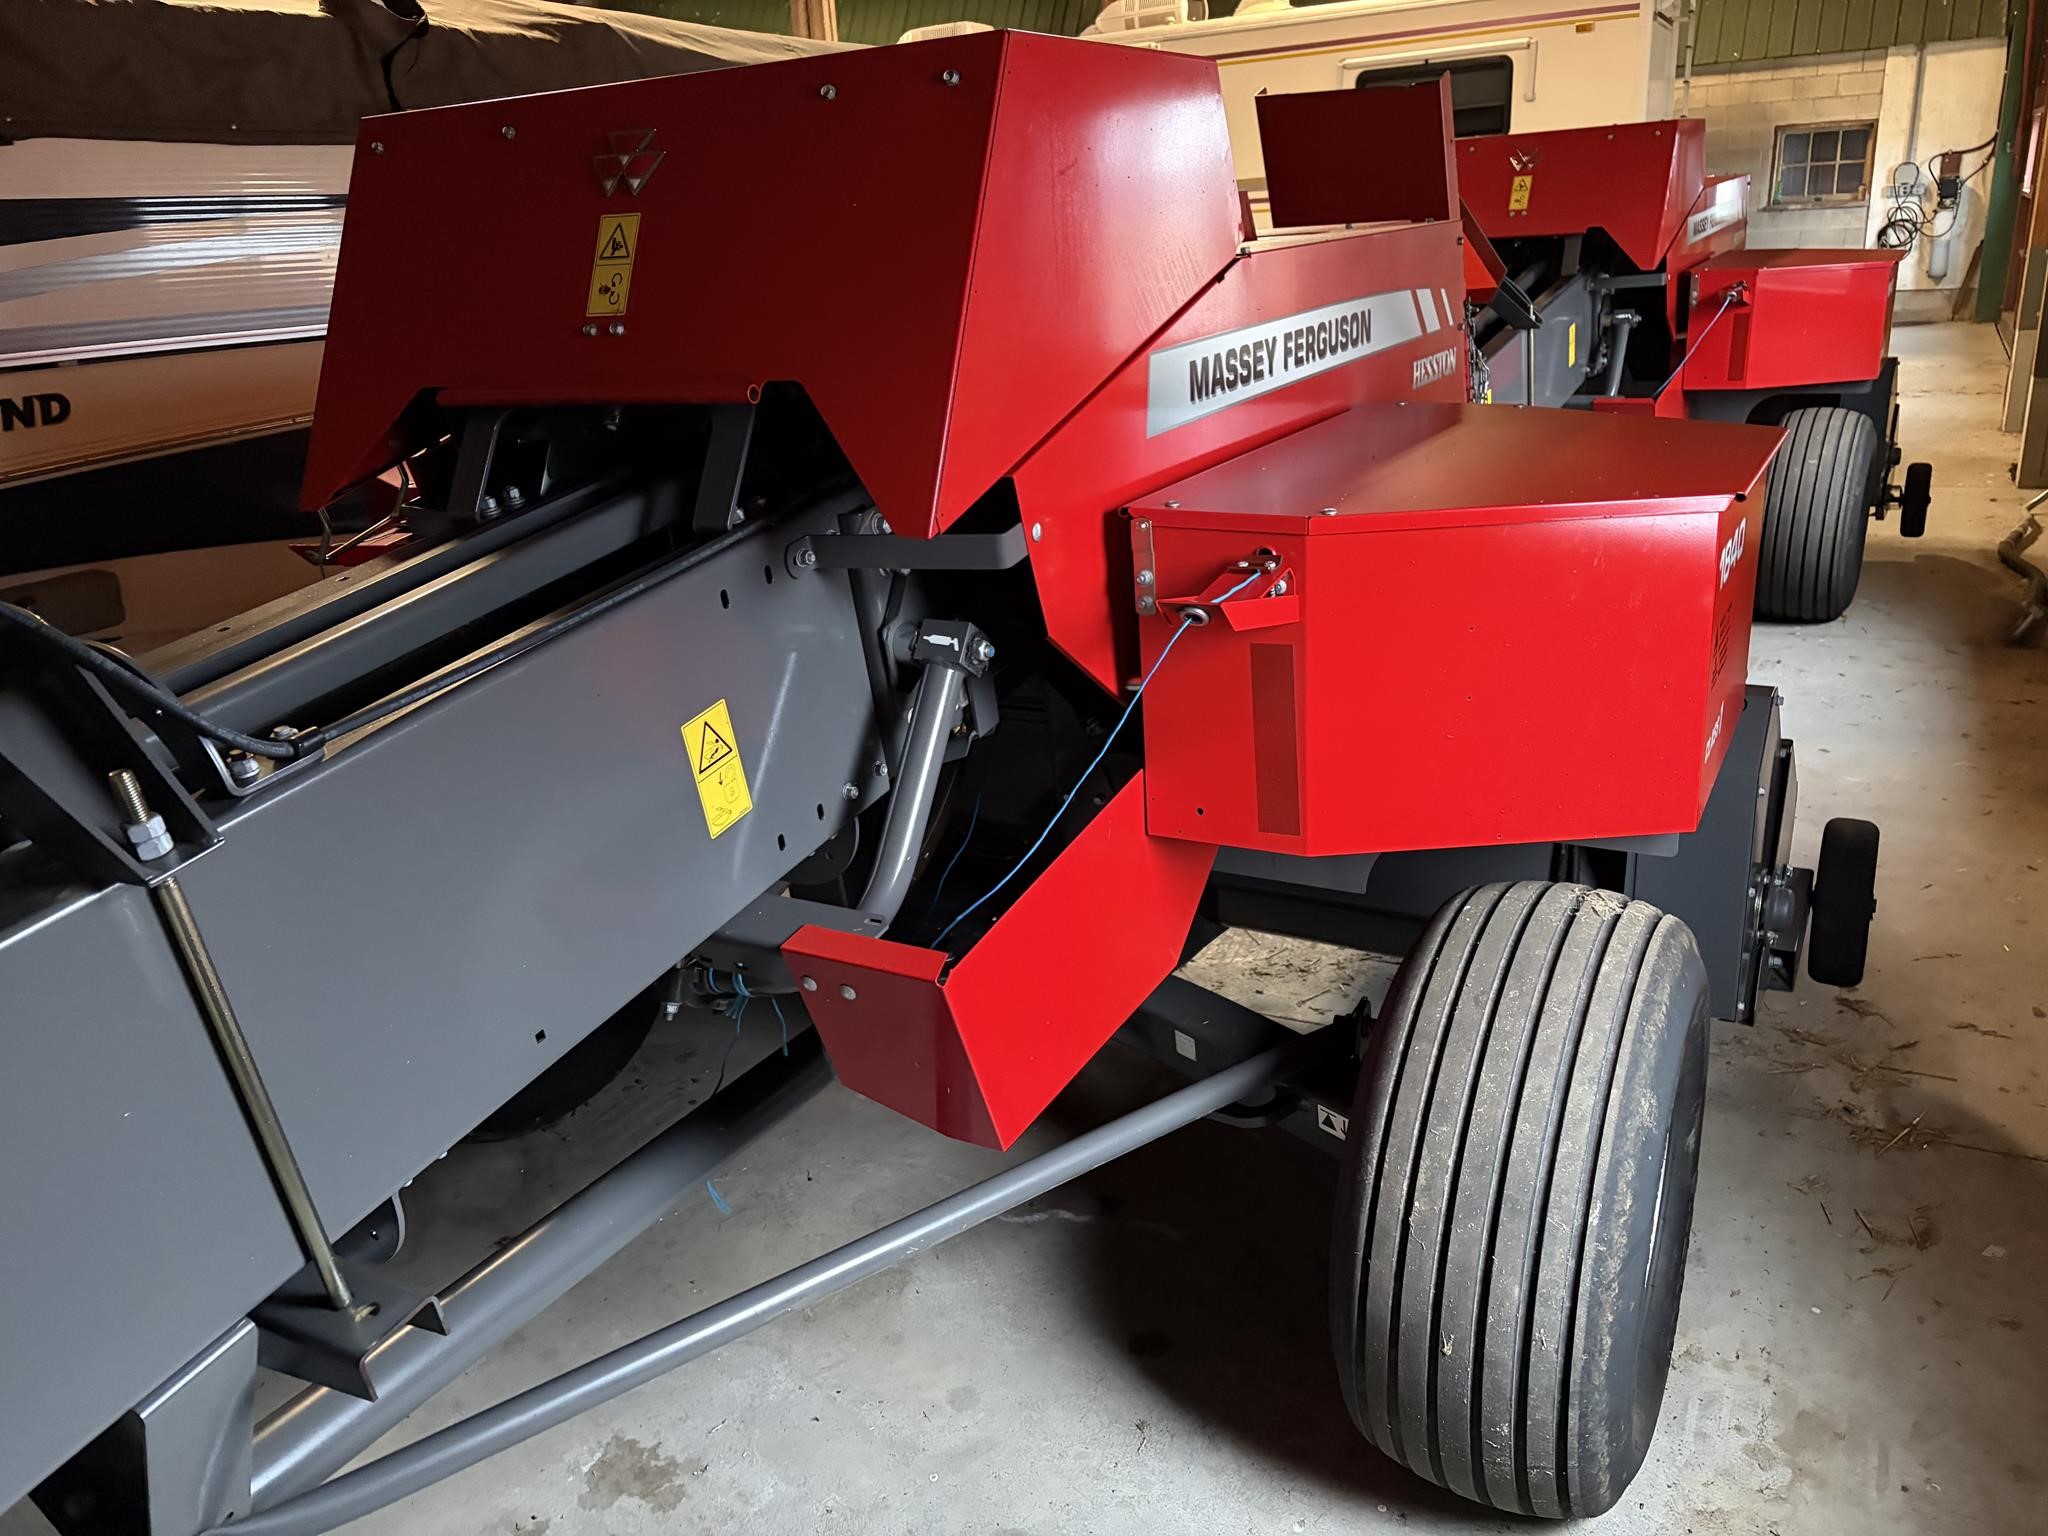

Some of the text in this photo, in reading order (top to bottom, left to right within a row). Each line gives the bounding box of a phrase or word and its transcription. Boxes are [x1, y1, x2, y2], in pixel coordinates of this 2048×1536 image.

[1189, 308, 1372, 404] MASSEY FERGUSON
[1413, 346, 1457, 390] HESSTON
[1719, 517, 1747, 591] 1840
